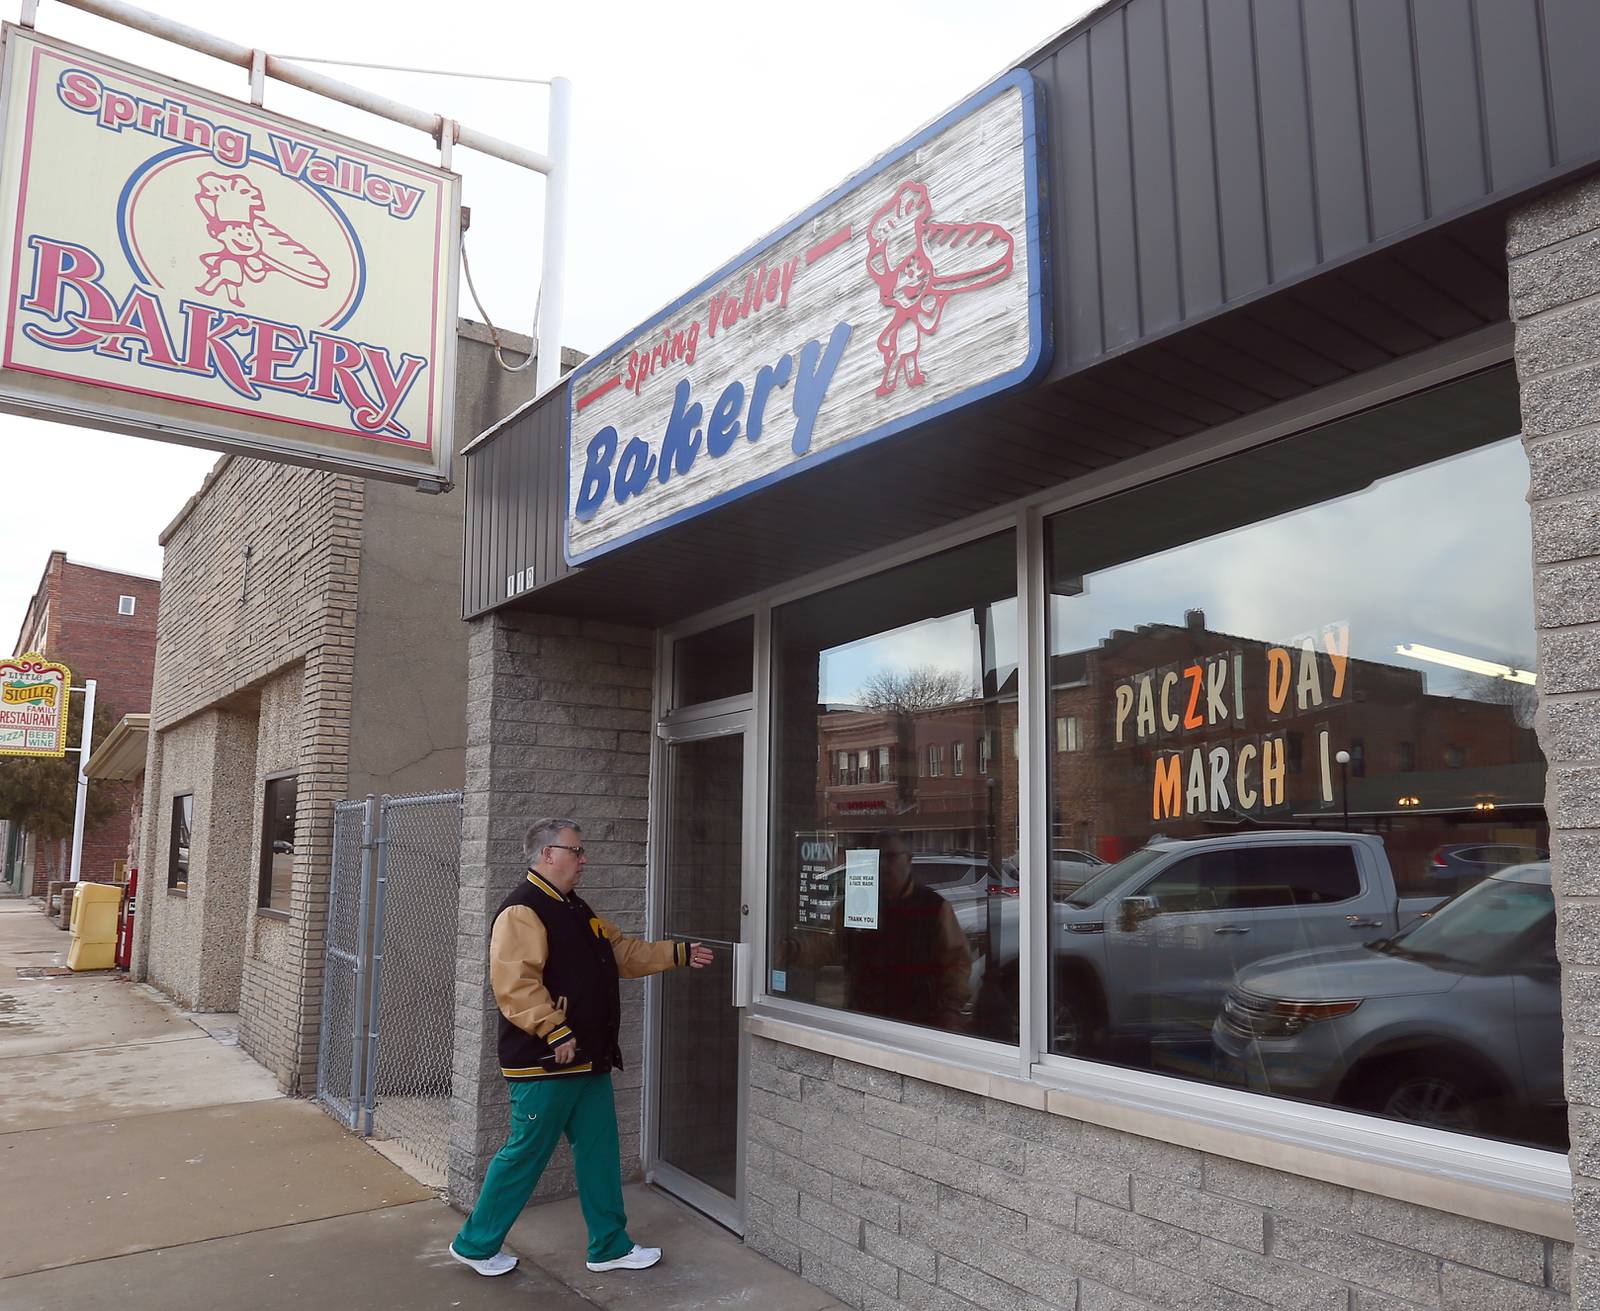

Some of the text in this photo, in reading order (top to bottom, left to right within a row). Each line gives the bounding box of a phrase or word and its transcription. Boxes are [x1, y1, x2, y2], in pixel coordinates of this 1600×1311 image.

[57, 68, 425, 219] Spring Valley
[20, 234, 428, 438] BAKERY
[624, 255, 800, 397] Spring Valley
[574, 321, 852, 522] Bakery
[8, 671, 42, 681] LITTLE
[1115, 624, 1350, 743] PACZKI DAY
[5, 685, 54, 702] SICILIA
[0, 710, 57, 727] RESTAURANT
[26, 705, 57, 714] FAMILY
[28, 730, 55, 740] BEER
[28, 739, 55, 748] WINE
[1153, 737, 1286, 820] MARCH
[801, 841, 834, 862] OPEN
